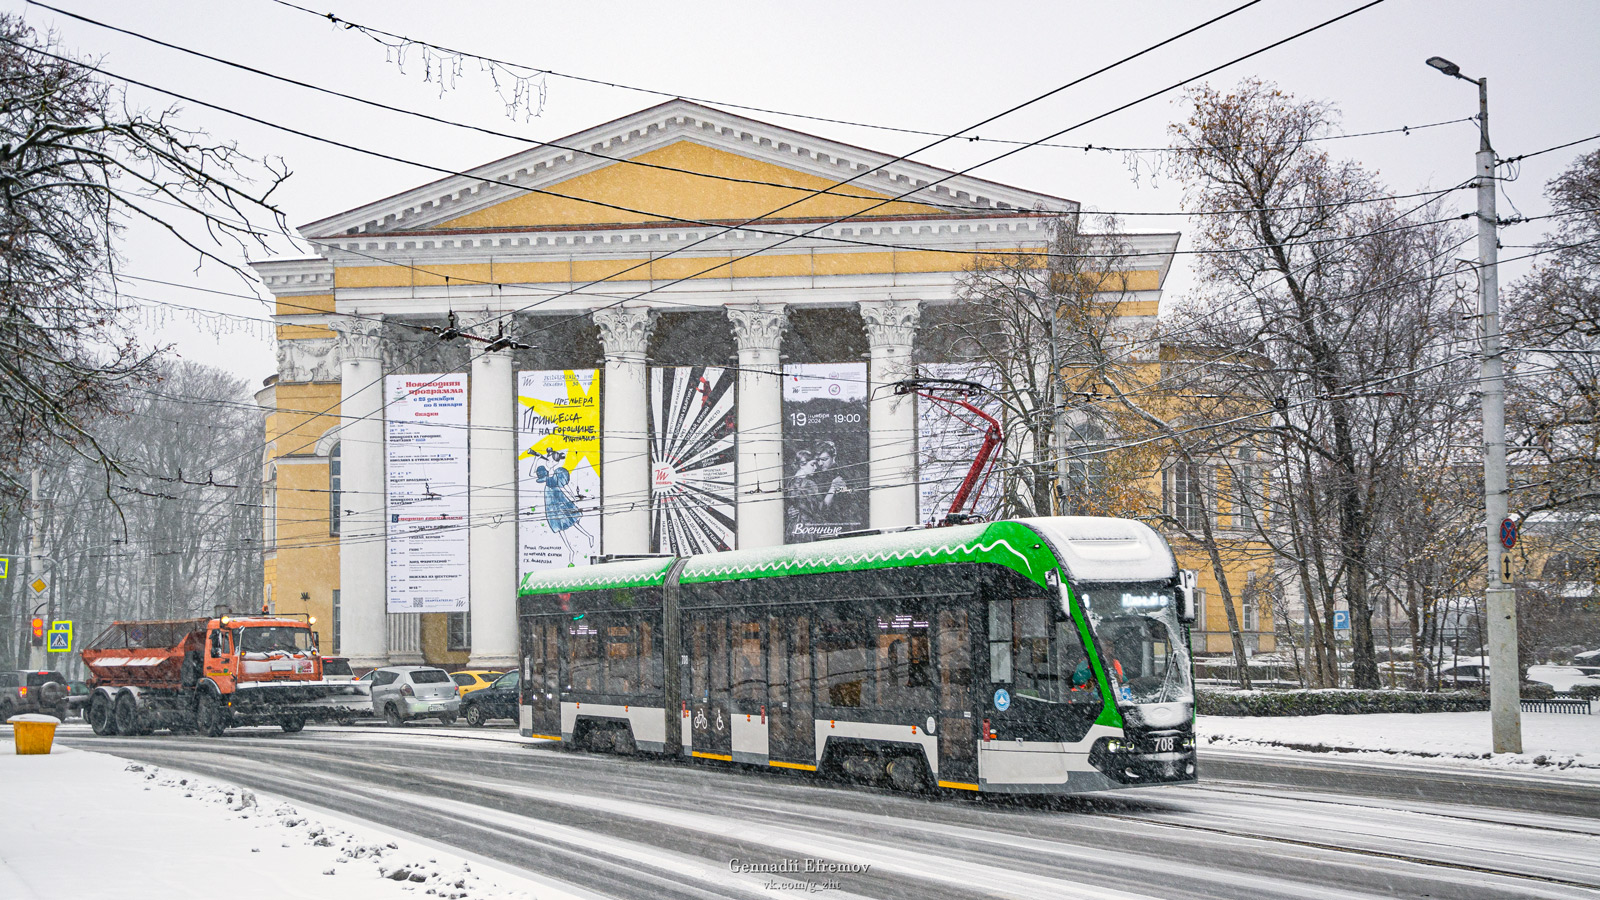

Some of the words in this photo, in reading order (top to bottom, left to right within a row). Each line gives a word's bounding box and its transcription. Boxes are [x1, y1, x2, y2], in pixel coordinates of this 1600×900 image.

[790, 412, 807, 426] 19
[833, 413, 861, 423] 19:00
[792, 522, 842, 535] Военные
[1334, 612, 1346, 628] P
[1154, 738, 1174, 752] 708
